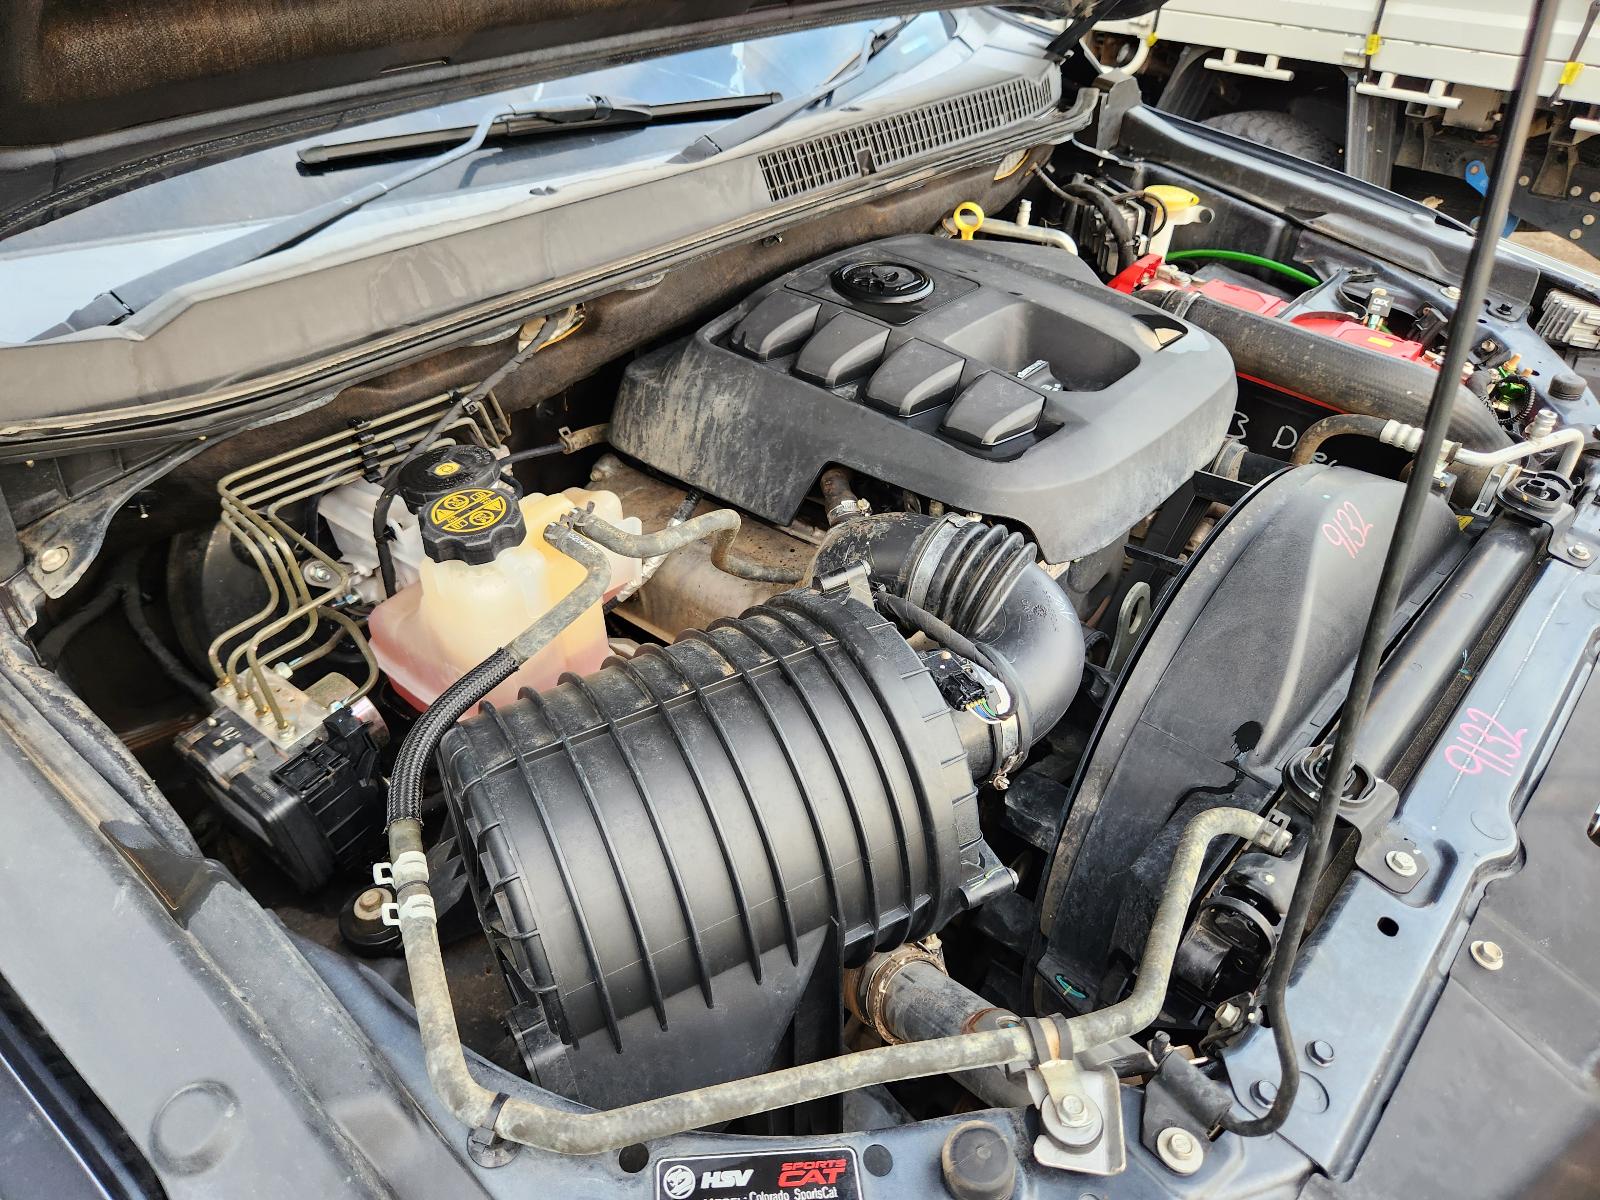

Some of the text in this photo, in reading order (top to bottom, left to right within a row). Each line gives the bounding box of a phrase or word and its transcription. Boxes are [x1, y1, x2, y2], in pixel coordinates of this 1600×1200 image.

[1322, 500, 1374, 559] 9132
[1444, 707, 1528, 777] 9132
[781, 1158, 847, 1171] SPORTS
[700, 1168, 754, 1189] HSV
[777, 1167, 846, 1188] CAT
[748, 1186, 838, 1200] Colorado SportsCat
